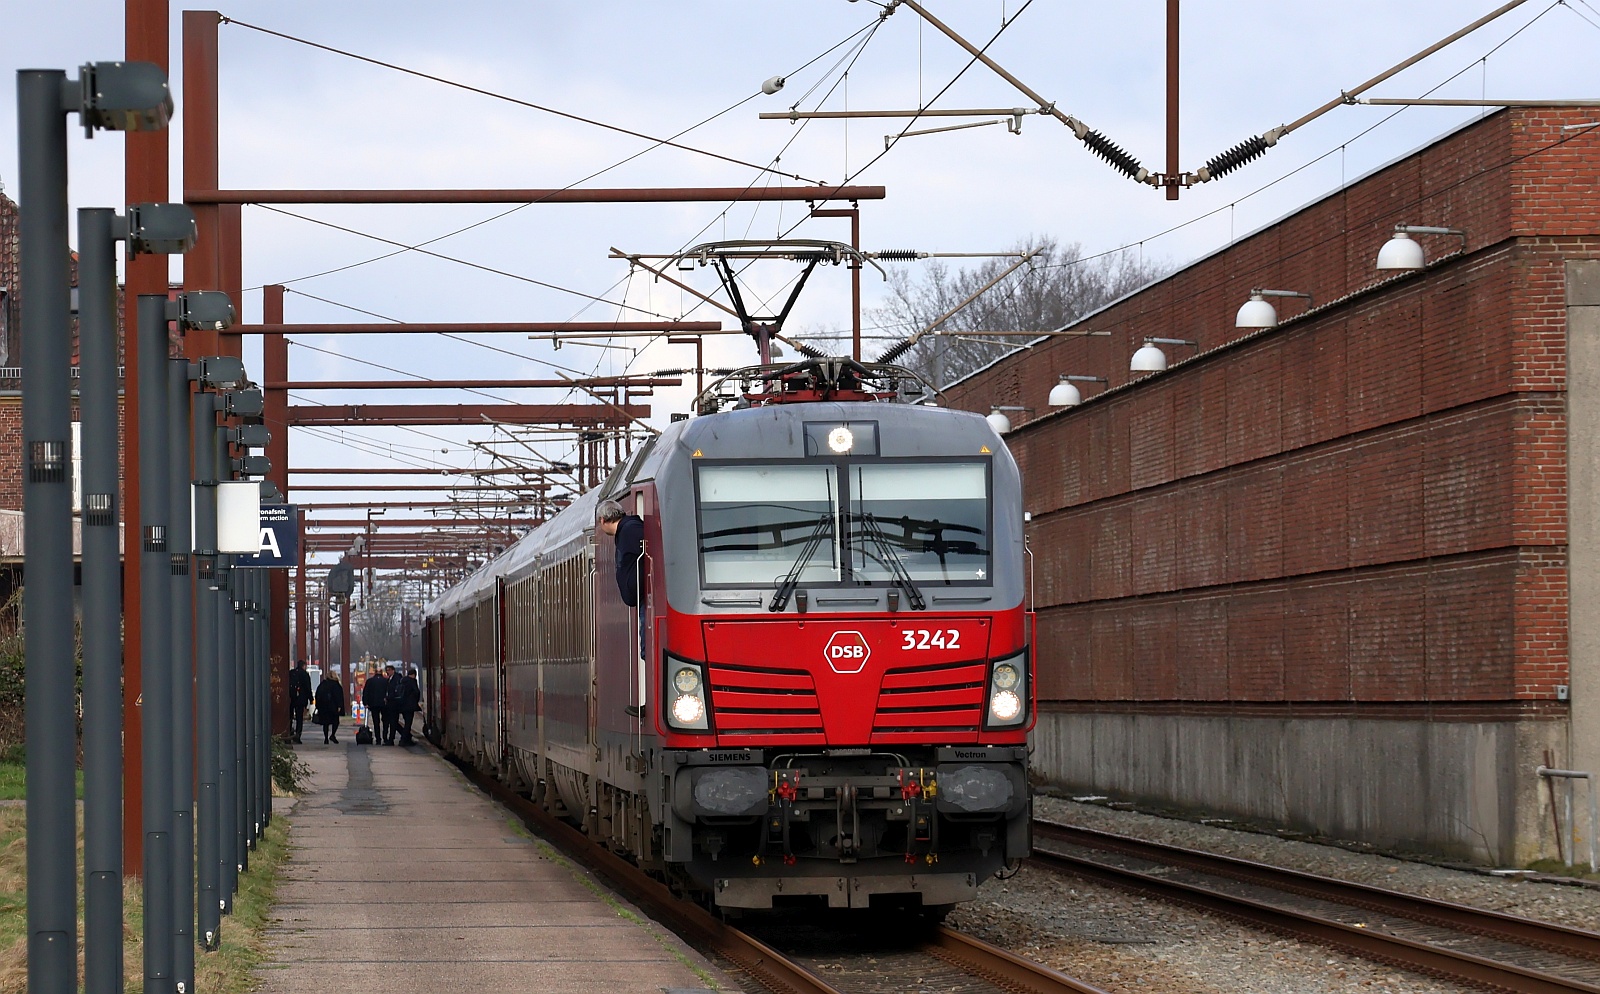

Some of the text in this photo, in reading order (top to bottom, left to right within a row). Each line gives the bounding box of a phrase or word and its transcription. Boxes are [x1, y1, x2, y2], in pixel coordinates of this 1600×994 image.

[253, 527, 282, 558] A
[901, 629, 960, 650] 3242
[831, 645, 864, 659] DSB
[709, 753, 751, 762] SIEMENS
[954, 750, 987, 758] Vectron
